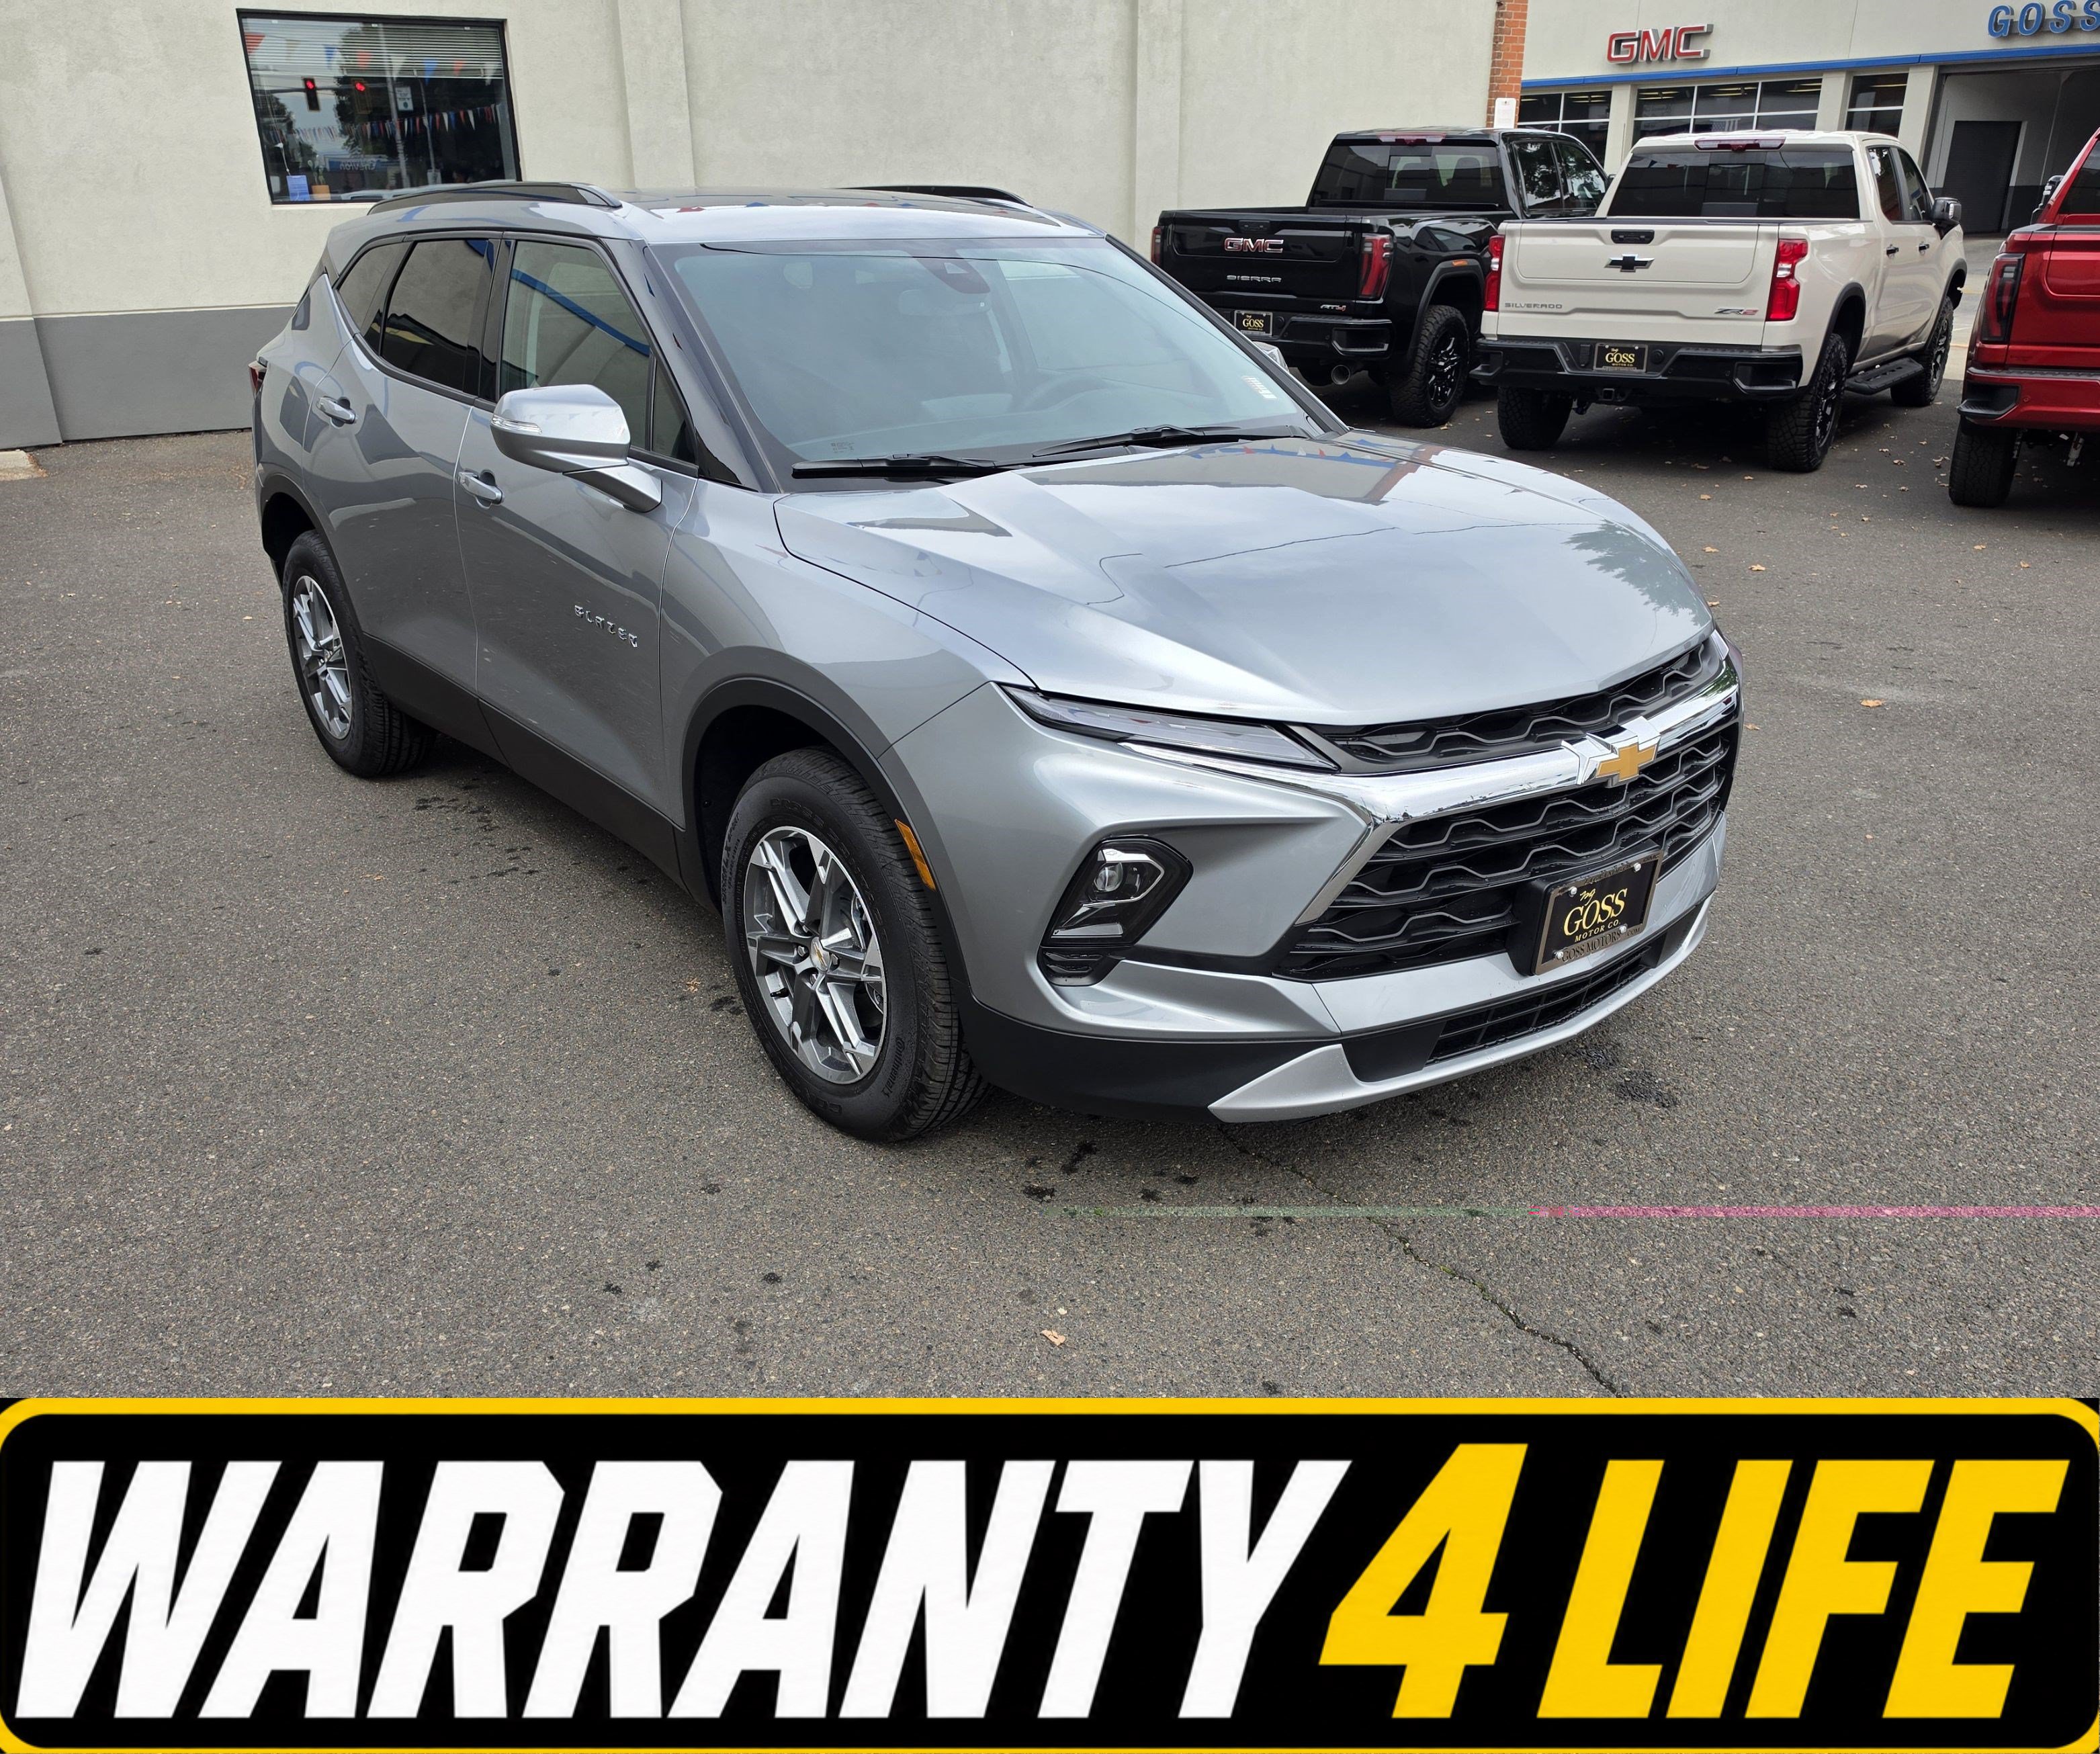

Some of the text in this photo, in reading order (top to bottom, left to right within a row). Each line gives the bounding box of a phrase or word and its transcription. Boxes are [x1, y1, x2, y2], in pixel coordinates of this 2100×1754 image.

[1988, 0, 2100, 38] GOSS
[1607, 24, 1714, 64] GMC
[1224, 237, 1284, 253] GMC
[1227, 275, 1282, 283] SIERRA
[1243, 318, 1264, 328] GOSS
[1605, 353, 1635, 363] GOSS
[574, 605, 638, 648] BLAZER
[1563, 888, 1628, 936] GOSS
[1575, 927, 1605, 942] MOTOR
[1562, 944, 1585, 963] GOSS
